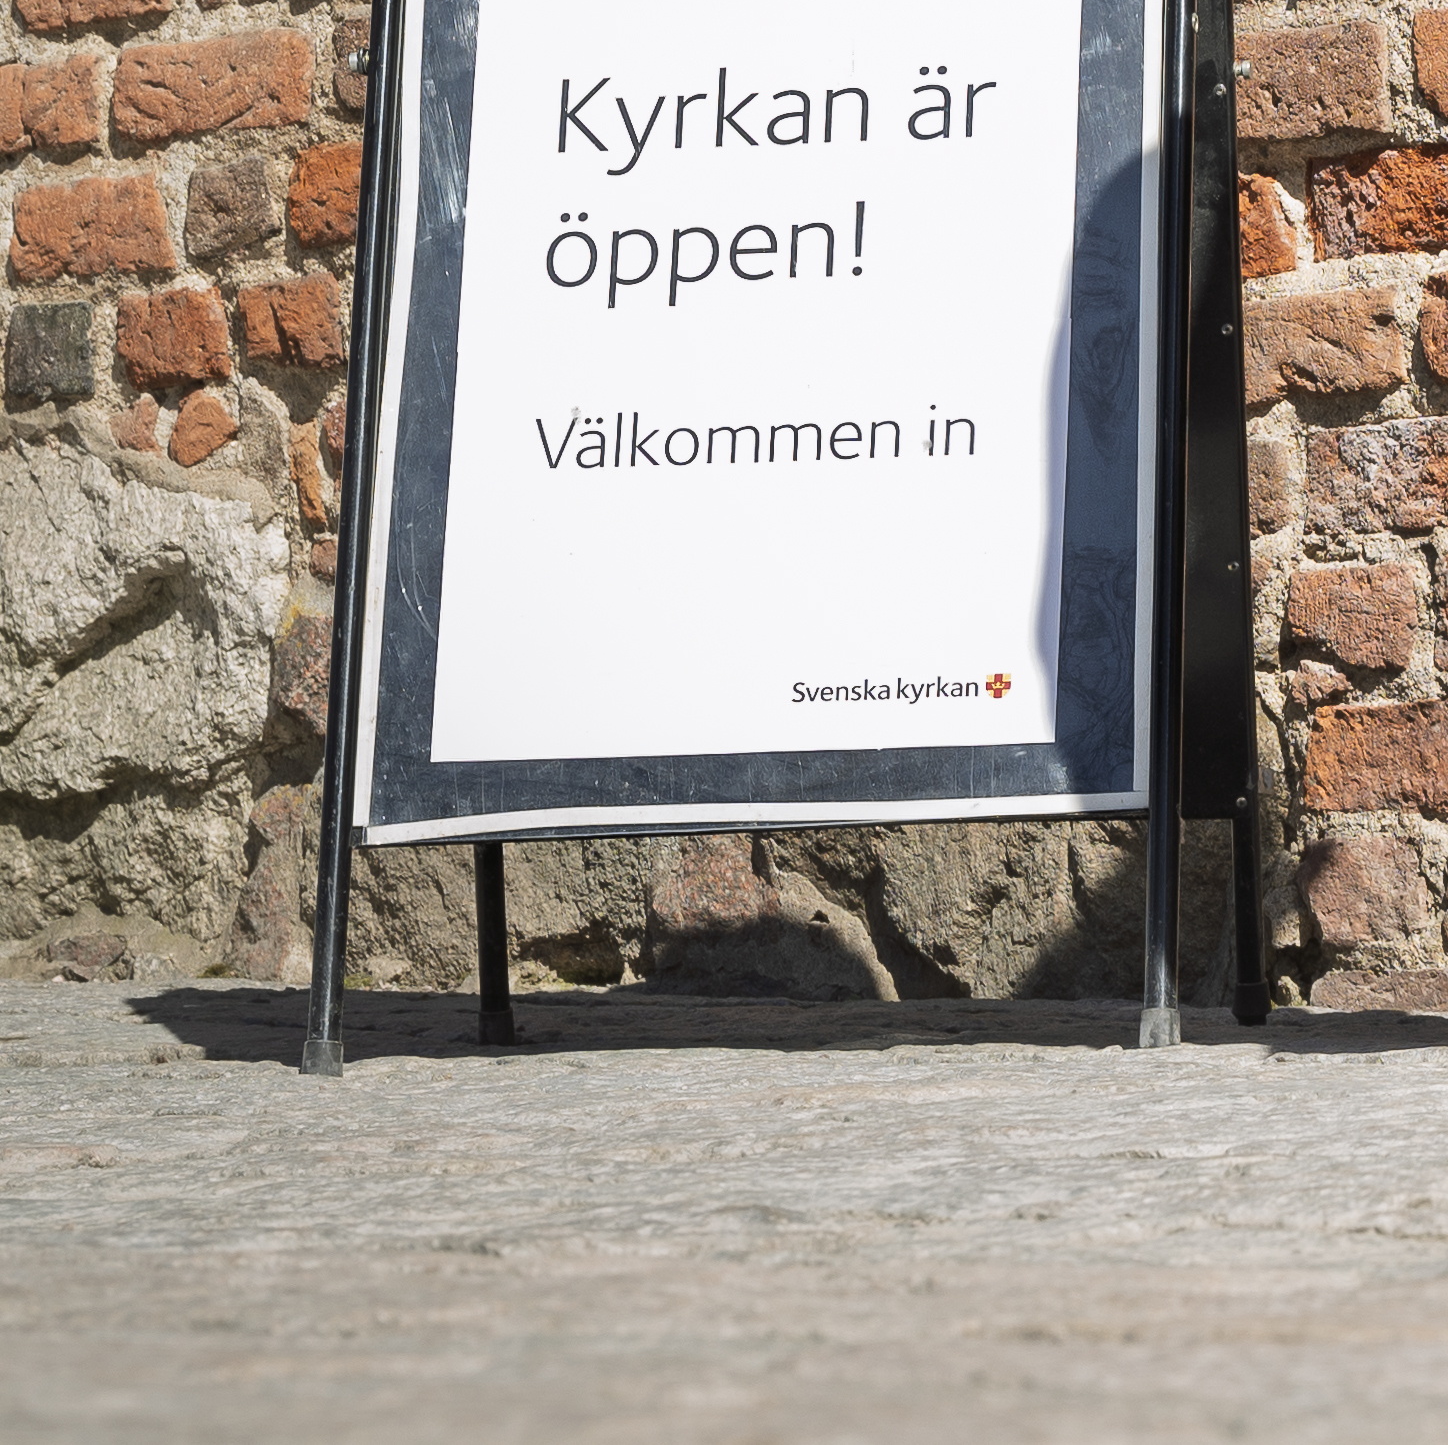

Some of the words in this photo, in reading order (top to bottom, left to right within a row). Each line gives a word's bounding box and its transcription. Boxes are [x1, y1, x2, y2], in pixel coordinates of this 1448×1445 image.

[556, 66, 870, 176] Kyrkan
[906, 64, 998, 142] är
[545, 199, 867, 310] öppen!
[534, 410, 902, 470] Välkommen
[927, 403, 976, 458] in
[791, 678, 891, 704] Svenska
[896, 676, 979, 705] kyrkan
